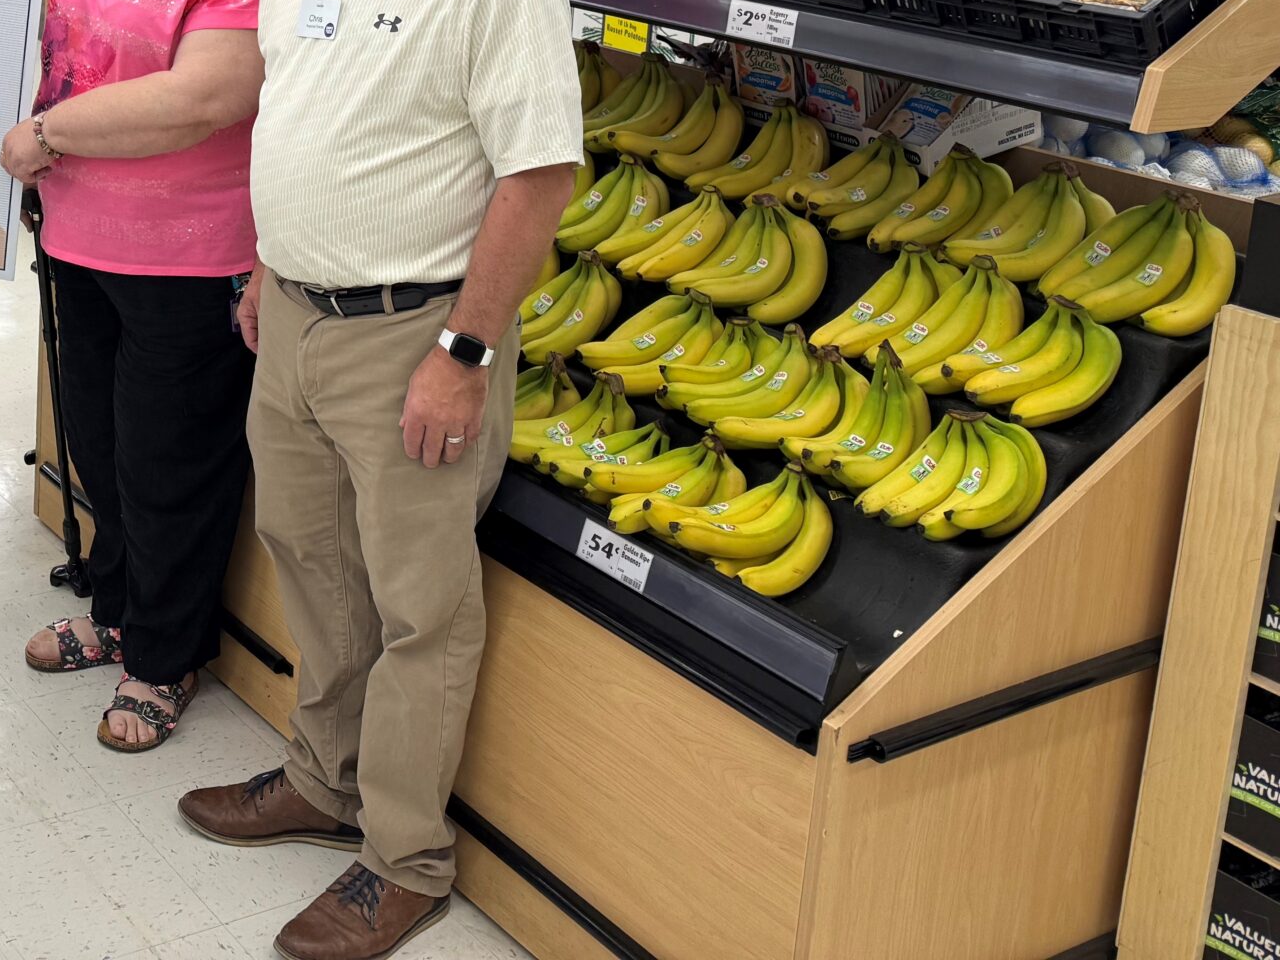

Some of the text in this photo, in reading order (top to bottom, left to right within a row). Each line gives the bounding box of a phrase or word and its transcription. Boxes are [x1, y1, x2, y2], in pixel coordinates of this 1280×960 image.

[770, 9, 789, 19] Regency
[607, 23, 648, 43] Russet Potatoes
[748, 75, 777, 88] SMOOTHIE
[621, 551, 641, 568] Bananas
[623, 543, 650, 564] Golden Ripe
